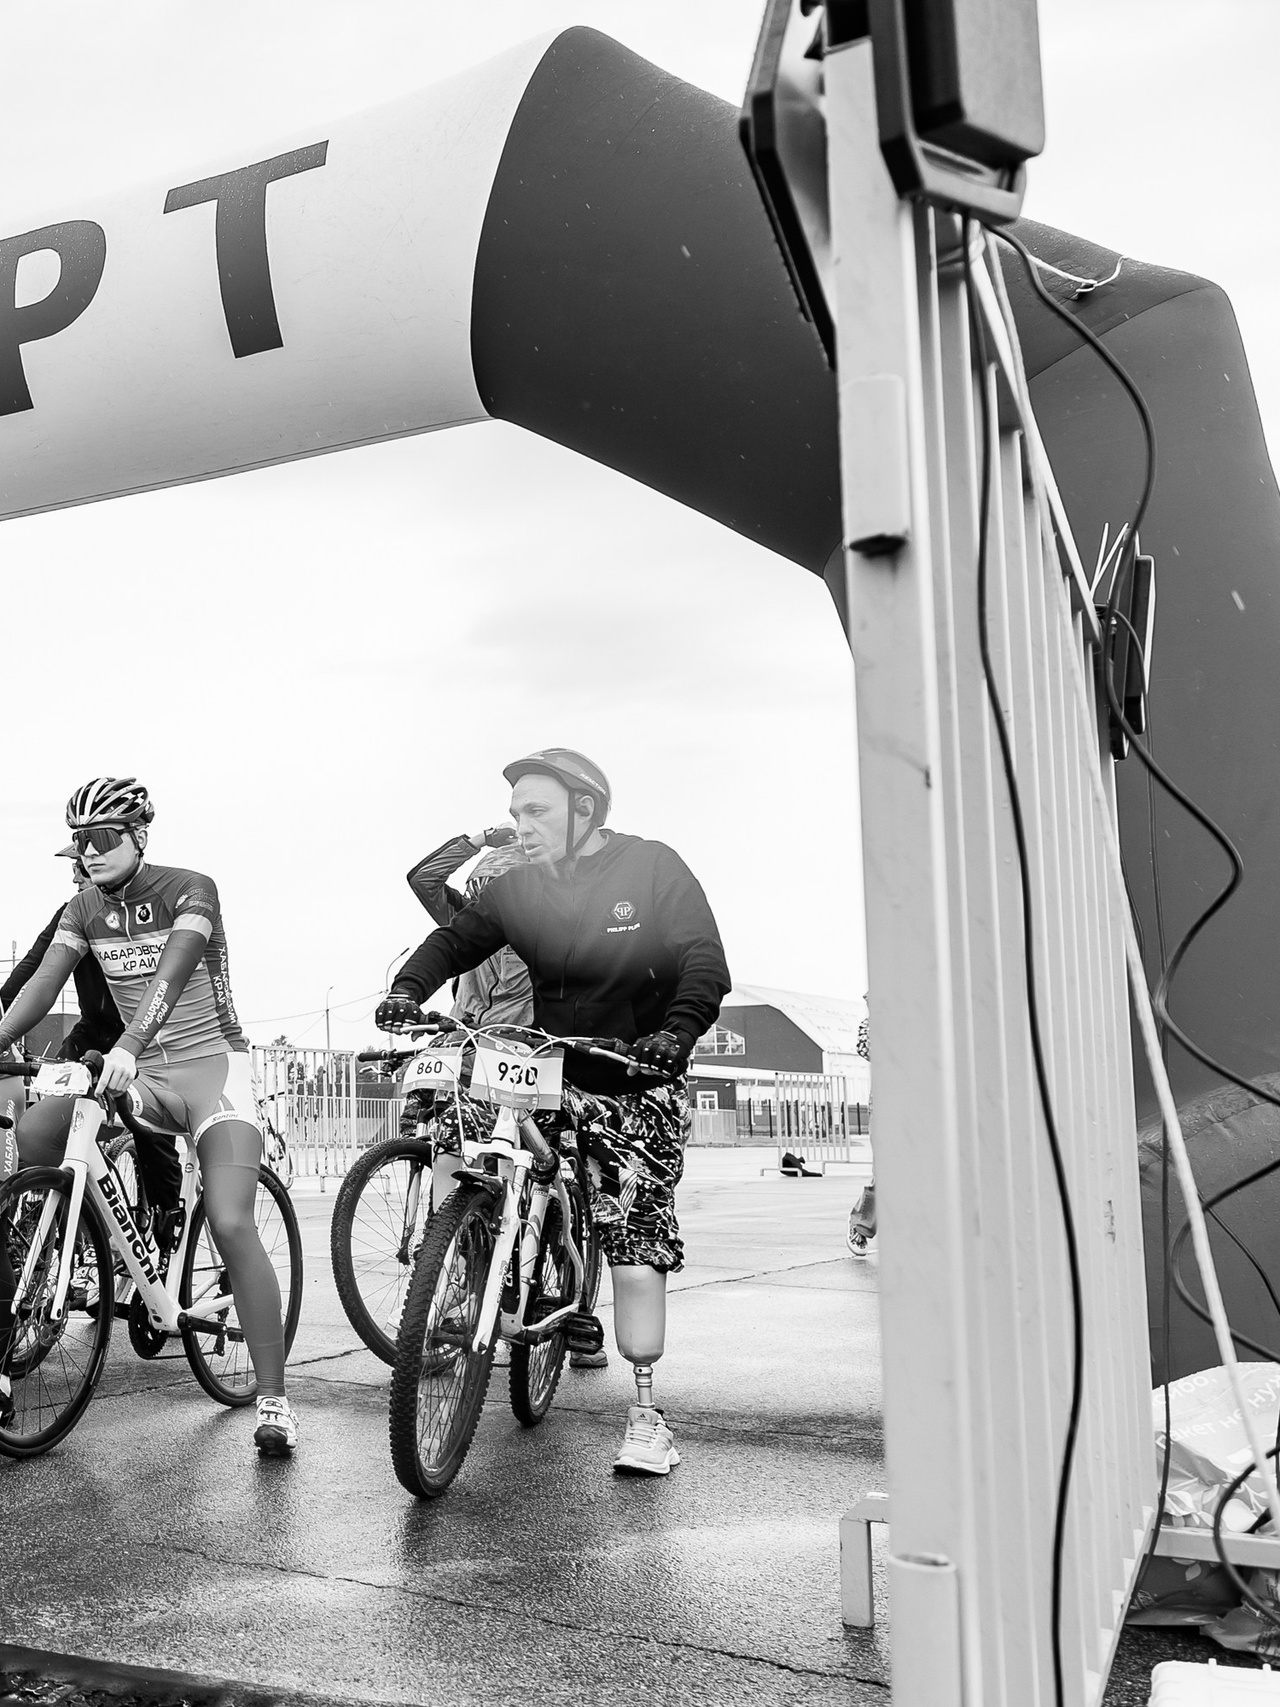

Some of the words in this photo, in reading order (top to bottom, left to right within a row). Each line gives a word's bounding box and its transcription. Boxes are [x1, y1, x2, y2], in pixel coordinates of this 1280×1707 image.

[122, 954, 157, 972] КРАЙ
[416, 1060, 443, 1075] 860
[498, 1061, 538, 1086] 930
[54, 1072, 72, 1087] 4
[96, 1172, 159, 1286] Bianchi
